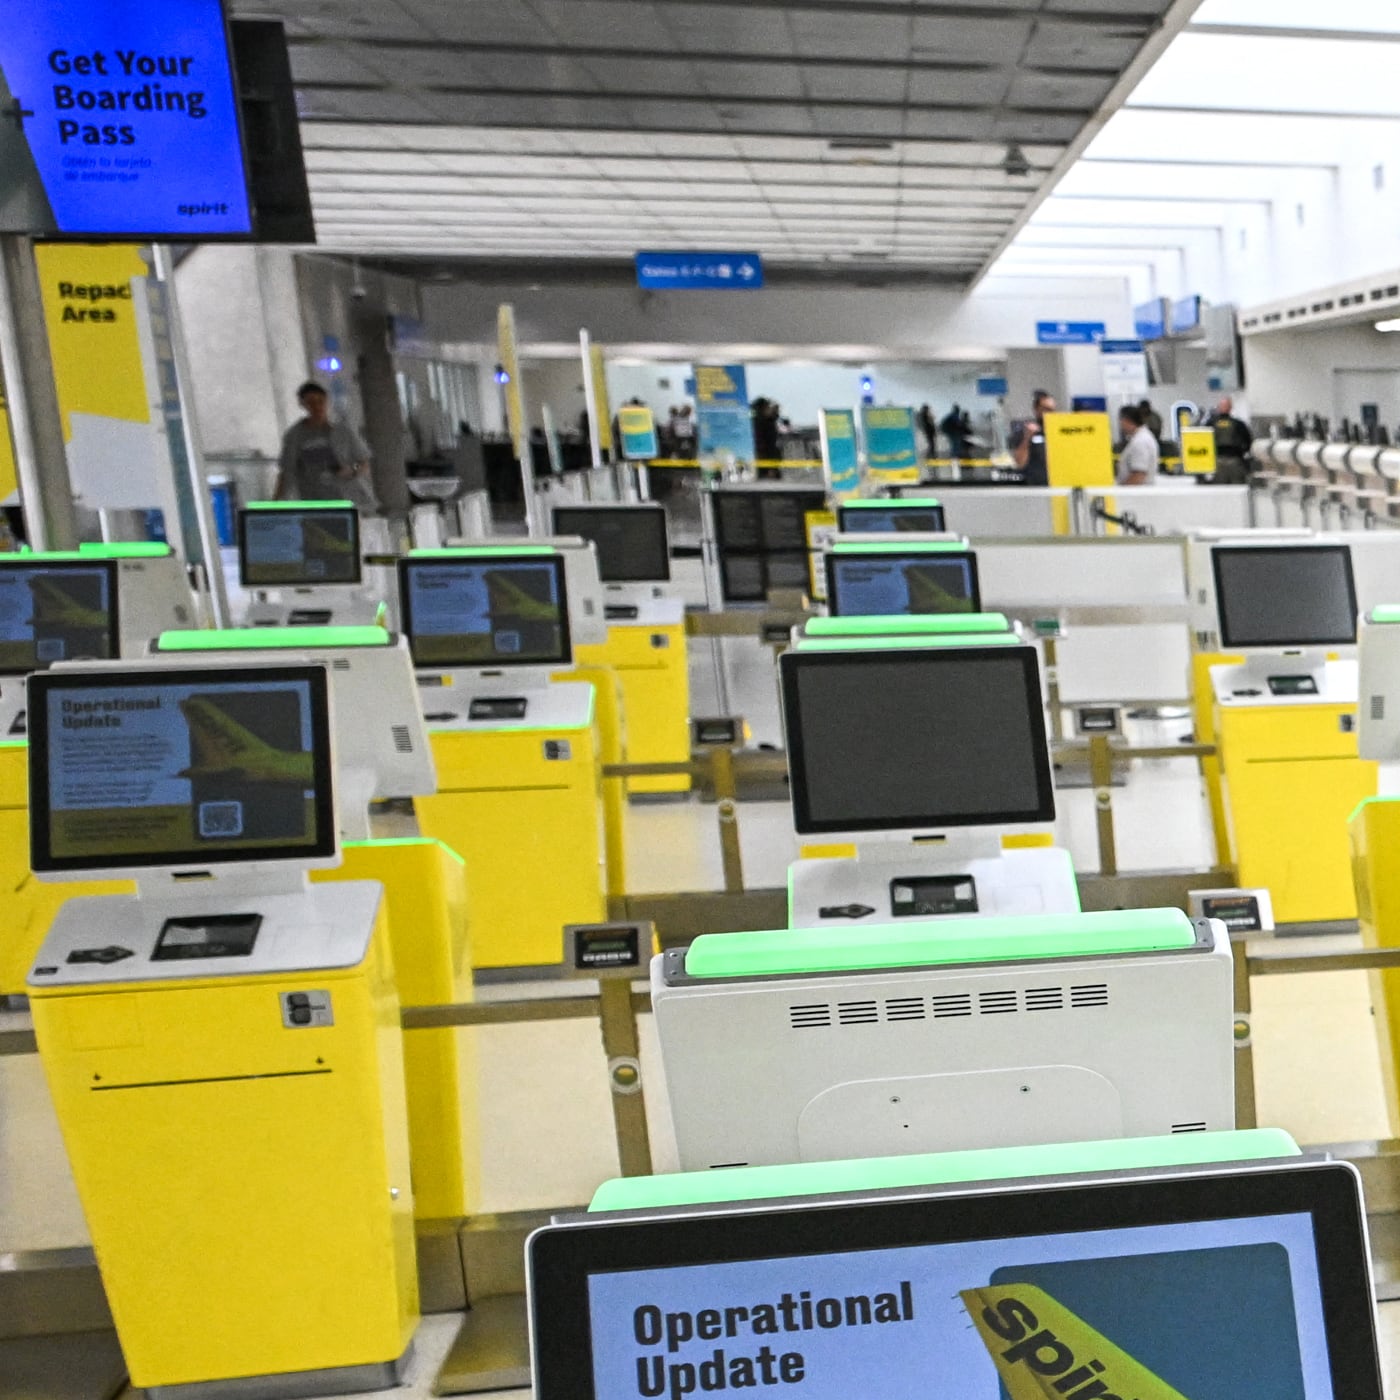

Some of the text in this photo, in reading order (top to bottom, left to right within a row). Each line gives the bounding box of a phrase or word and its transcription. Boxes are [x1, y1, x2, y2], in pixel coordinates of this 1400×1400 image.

[48, 50, 193, 76] Get Your
[53, 83, 207, 119] Boarding
[58, 120, 135, 145] Pass
[177, 203, 229, 215] spirit
[62, 306, 117, 323] Area
[633, 1281, 914, 1353] Operational
